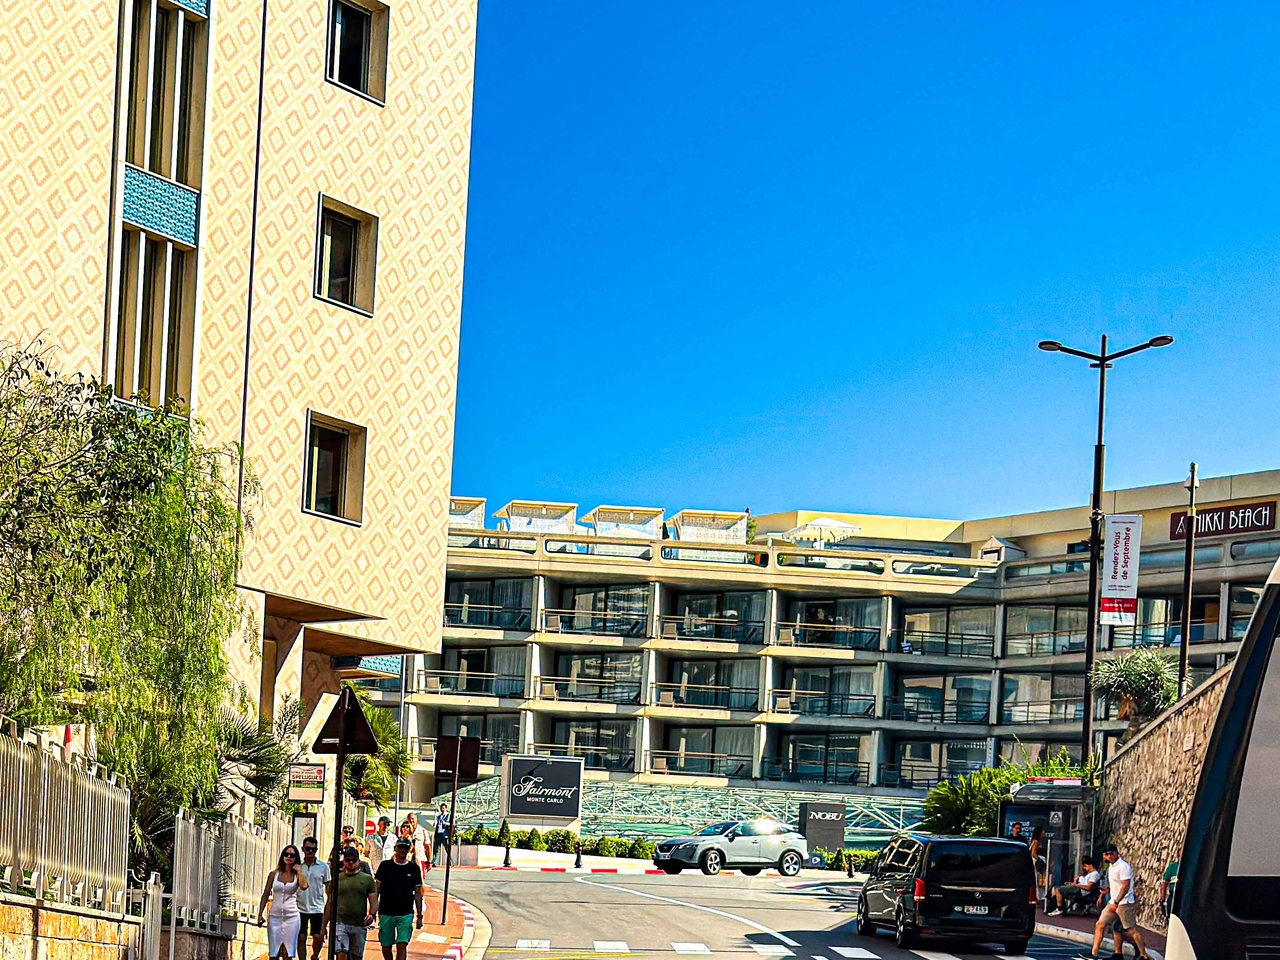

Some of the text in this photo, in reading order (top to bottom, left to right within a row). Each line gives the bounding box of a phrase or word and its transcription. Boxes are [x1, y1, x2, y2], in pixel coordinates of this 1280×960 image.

[1229, 506, 1270, 529] BEACH
[1111, 531, 1121, 580] Rendez-Vous
[1121, 526, 1131, 580] de Septembre
[512, 775, 578, 799] Fairmont
[809, 811, 843, 821] NOBU
